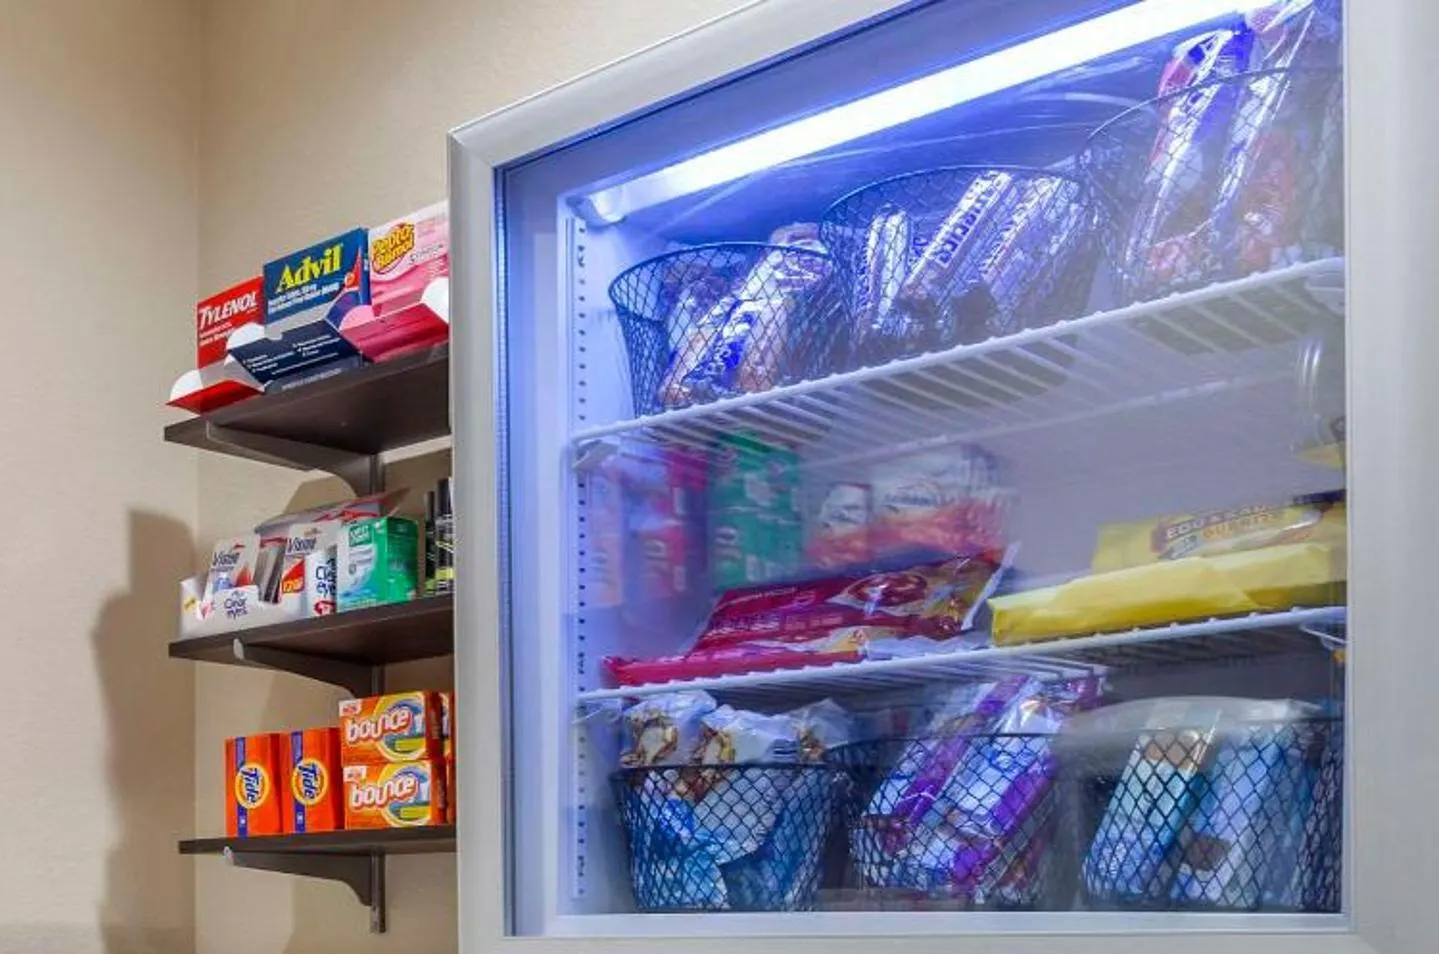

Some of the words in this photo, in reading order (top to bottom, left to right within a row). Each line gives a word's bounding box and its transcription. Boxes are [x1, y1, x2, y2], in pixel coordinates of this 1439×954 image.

[276, 243, 343, 292] Advil
[200, 291, 257, 329] TYLENOL
[241, 767, 261, 803] Tide
[297, 762, 319, 799] Tide
